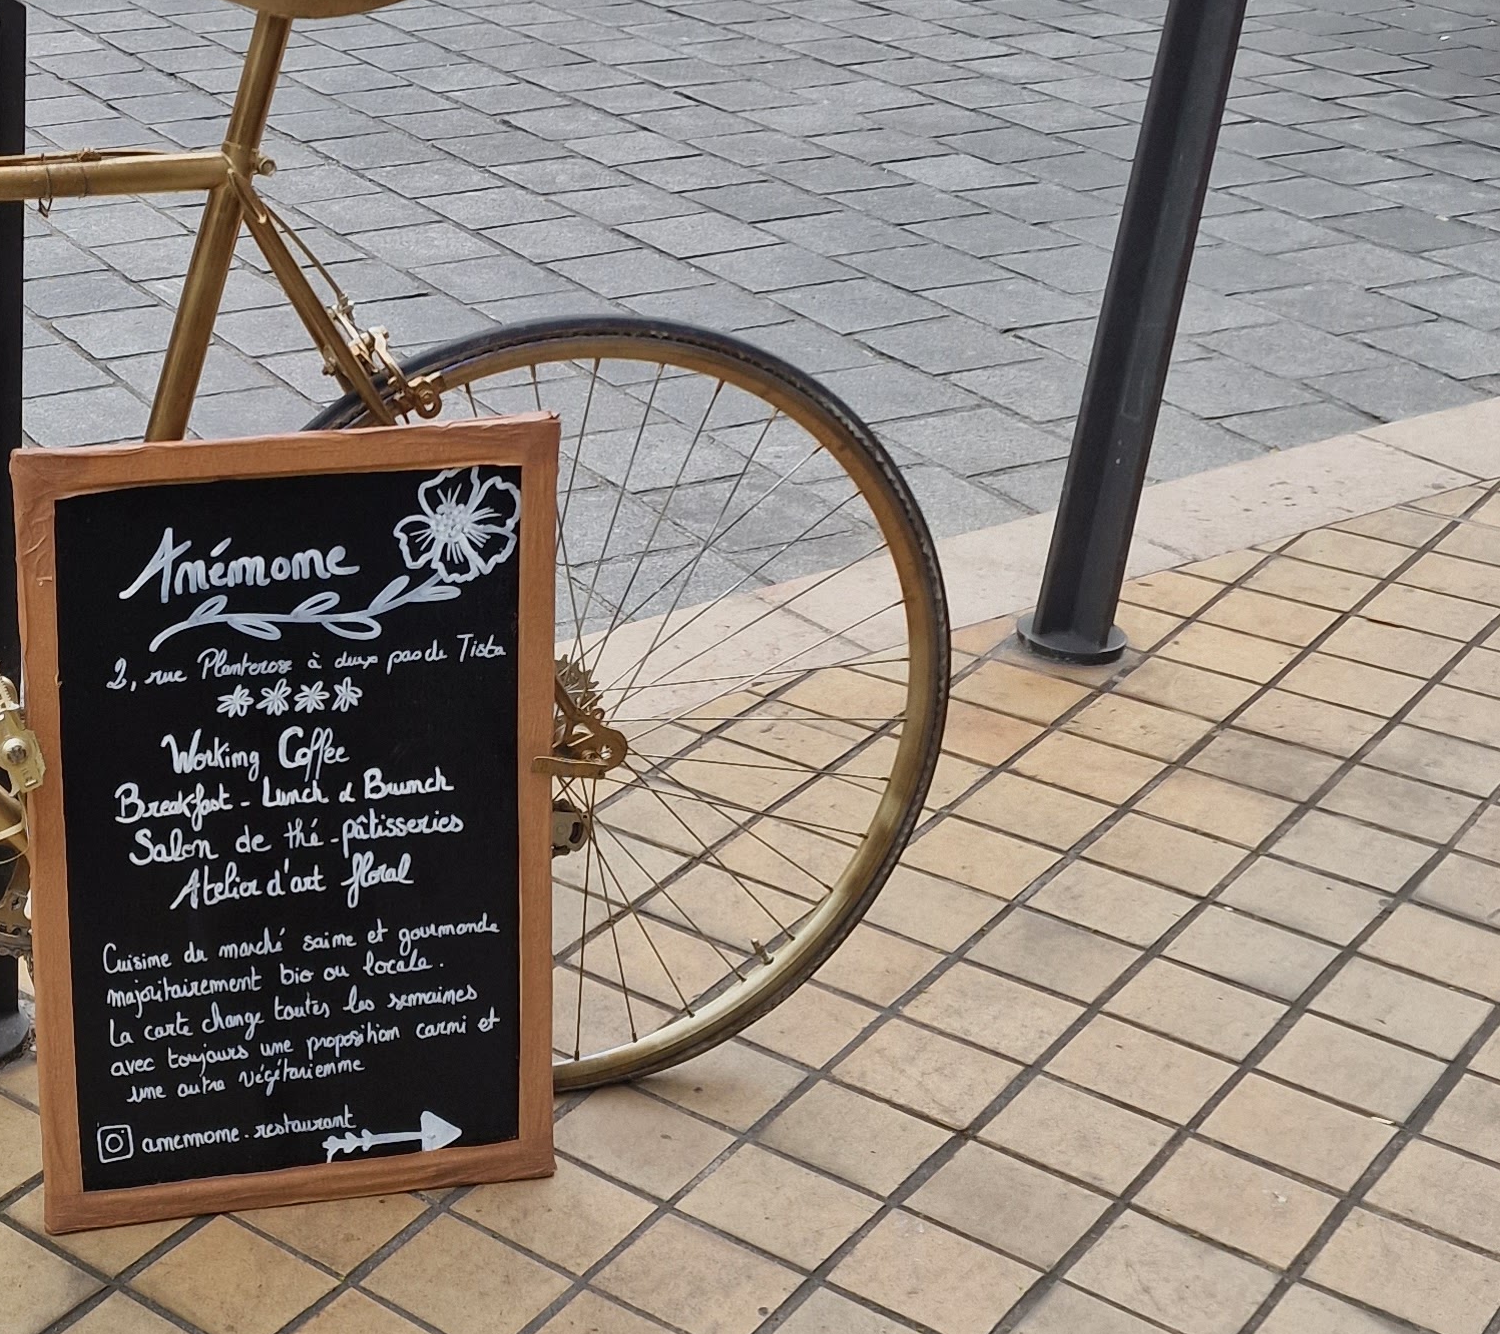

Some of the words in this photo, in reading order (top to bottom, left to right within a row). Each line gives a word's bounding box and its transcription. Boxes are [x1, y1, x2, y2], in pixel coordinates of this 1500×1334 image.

[118, 526, 361, 604] Anémone
[144, 668, 188, 685] rue
[307, 651, 323, 670] à
[334, 650, 379, 670] deux
[160, 727, 261, 782] Working
[278, 725, 350, 782] Coffee
[115, 781, 234, 832] Breakfast
[262, 775, 330, 808] Lunch
[363, 765, 455, 801] Brunch
[128, 827, 219, 866] Salon
[234, 824, 273, 854] de
[283, 817, 325, 850] thé
[169, 860, 263, 911] Atelier
[341, 851, 415, 909] floral
[102, 942, 172, 974] Cuisine
[183, 940, 209, 964] du
[218, 926, 286, 959] marché
[302, 931, 358, 952] saine
[366, 917, 389, 945] et
[398, 911, 500, 957] gourmande
[106, 965, 263, 1019] majoritairement
[279, 962, 315, 986] bio
[323, 965, 350, 982] ou
[143, 1011, 194, 1041] carte
[201, 1000, 265, 1041] change
[273, 991, 331, 1021] toutes
[343, 984, 376, 1014] les
[386, 983, 478, 1011] semaines
[110, 1057, 156, 1077] avec
[167, 1043, 249, 1078] toujours
[260, 1038, 295, 1057] une
[305, 1021, 401, 1061] proposition
[477, 1006, 501, 1033] et
[126, 1084, 167, 1103] une
[176, 1075, 226, 1098] autre
